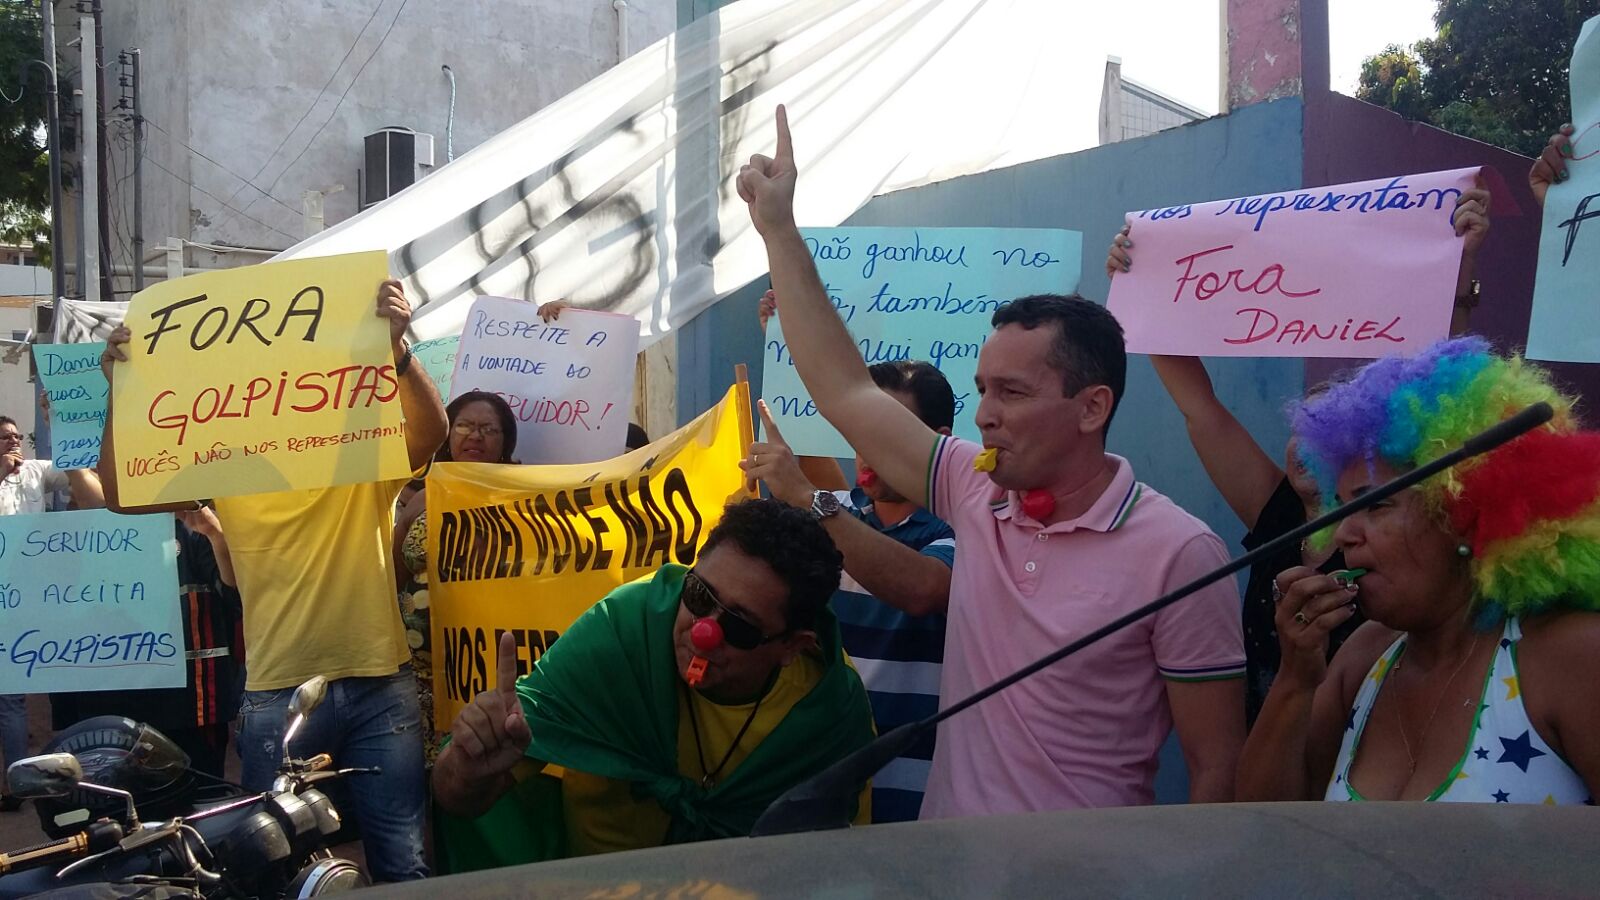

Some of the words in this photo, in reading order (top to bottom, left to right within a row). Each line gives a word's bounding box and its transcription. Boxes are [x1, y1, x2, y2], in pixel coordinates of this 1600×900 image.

[862, 230, 969, 279] ganhou
[993, 248, 1060, 268] no
[1173, 245, 1321, 303] Fora
[143, 285, 325, 355] FORA
[474, 310, 571, 345] RESPEITE
[586, 331, 607, 347] A
[462, 353, 470, 371] A
[478, 355, 548, 375] VONTADE
[126, 449, 181, 478] VOCÊS
[194, 441, 232, 466] NÃO
[244, 440, 279, 457] NOS
[437, 504, 524, 583] DANIEL
[515, 472, 613, 576] VOCÊ
[605, 454, 703, 569] NÃO
[21, 528, 143, 557] SERVIDOR
[43, 580, 145, 604] ACEITA
[443, 626, 488, 704] NOS
